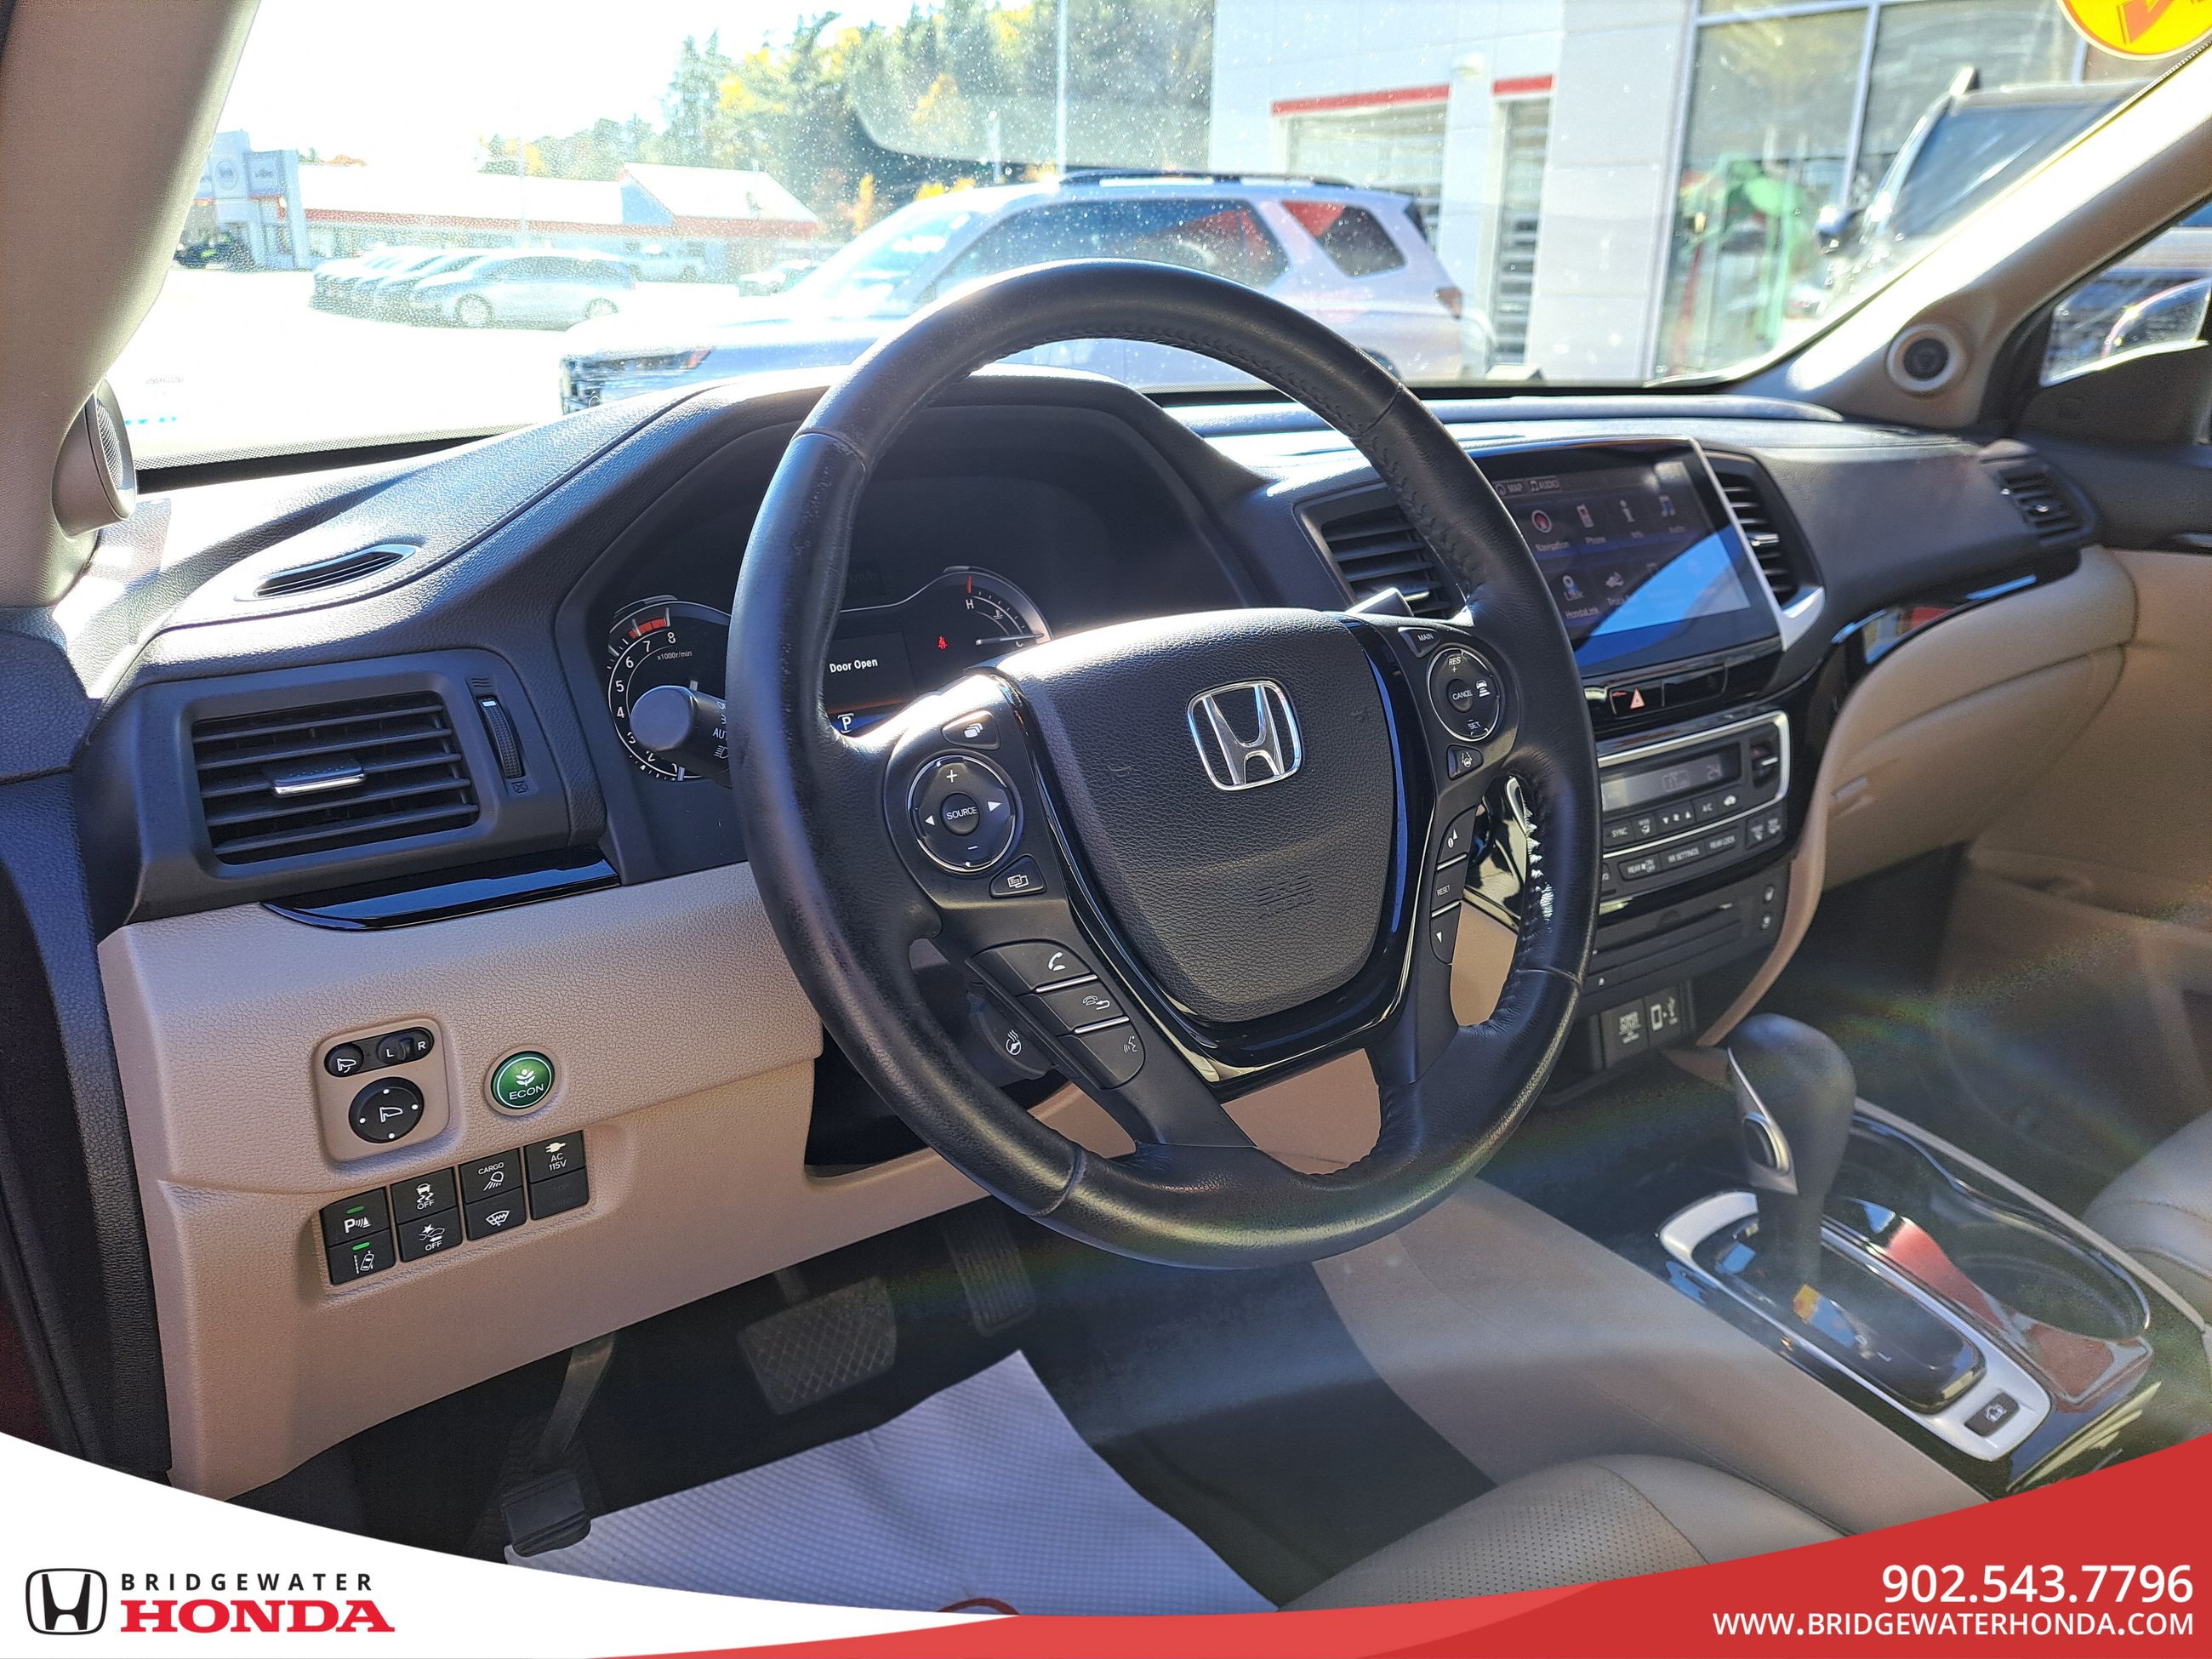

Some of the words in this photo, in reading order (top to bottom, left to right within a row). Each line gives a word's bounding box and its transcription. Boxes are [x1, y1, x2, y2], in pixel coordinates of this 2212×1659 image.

[1536, 541, 1571, 551] Navigation
[965, 599, 975, 609] H
[667, 632, 676, 644] 8
[1417, 633, 1434, 641] MAIN
[643, 640, 651, 653] 7
[625, 656, 634, 668] 6
[829, 663, 852, 673] Door
[853, 659, 878, 670] Open
[1448, 656, 1462, 665] RES
[615, 681, 624, 693] 5
[617, 707, 624, 718] 4
[841, 716, 852, 731] P
[1468, 721, 1480, 730] SET
[946, 807, 978, 820] SOURCE
[1436, 884, 1451, 896] RESET
[418, 1040, 425, 1051] R
[386, 1049, 394, 1058] L
[509, 1084, 544, 1100] ECON
[550, 1153, 564, 1163] AC
[478, 1162, 505, 1175] CARGO
[548, 1160, 567, 1172] 115V
[417, 1199, 435, 1210] OFF
[425, 1240, 442, 1251] OFF
